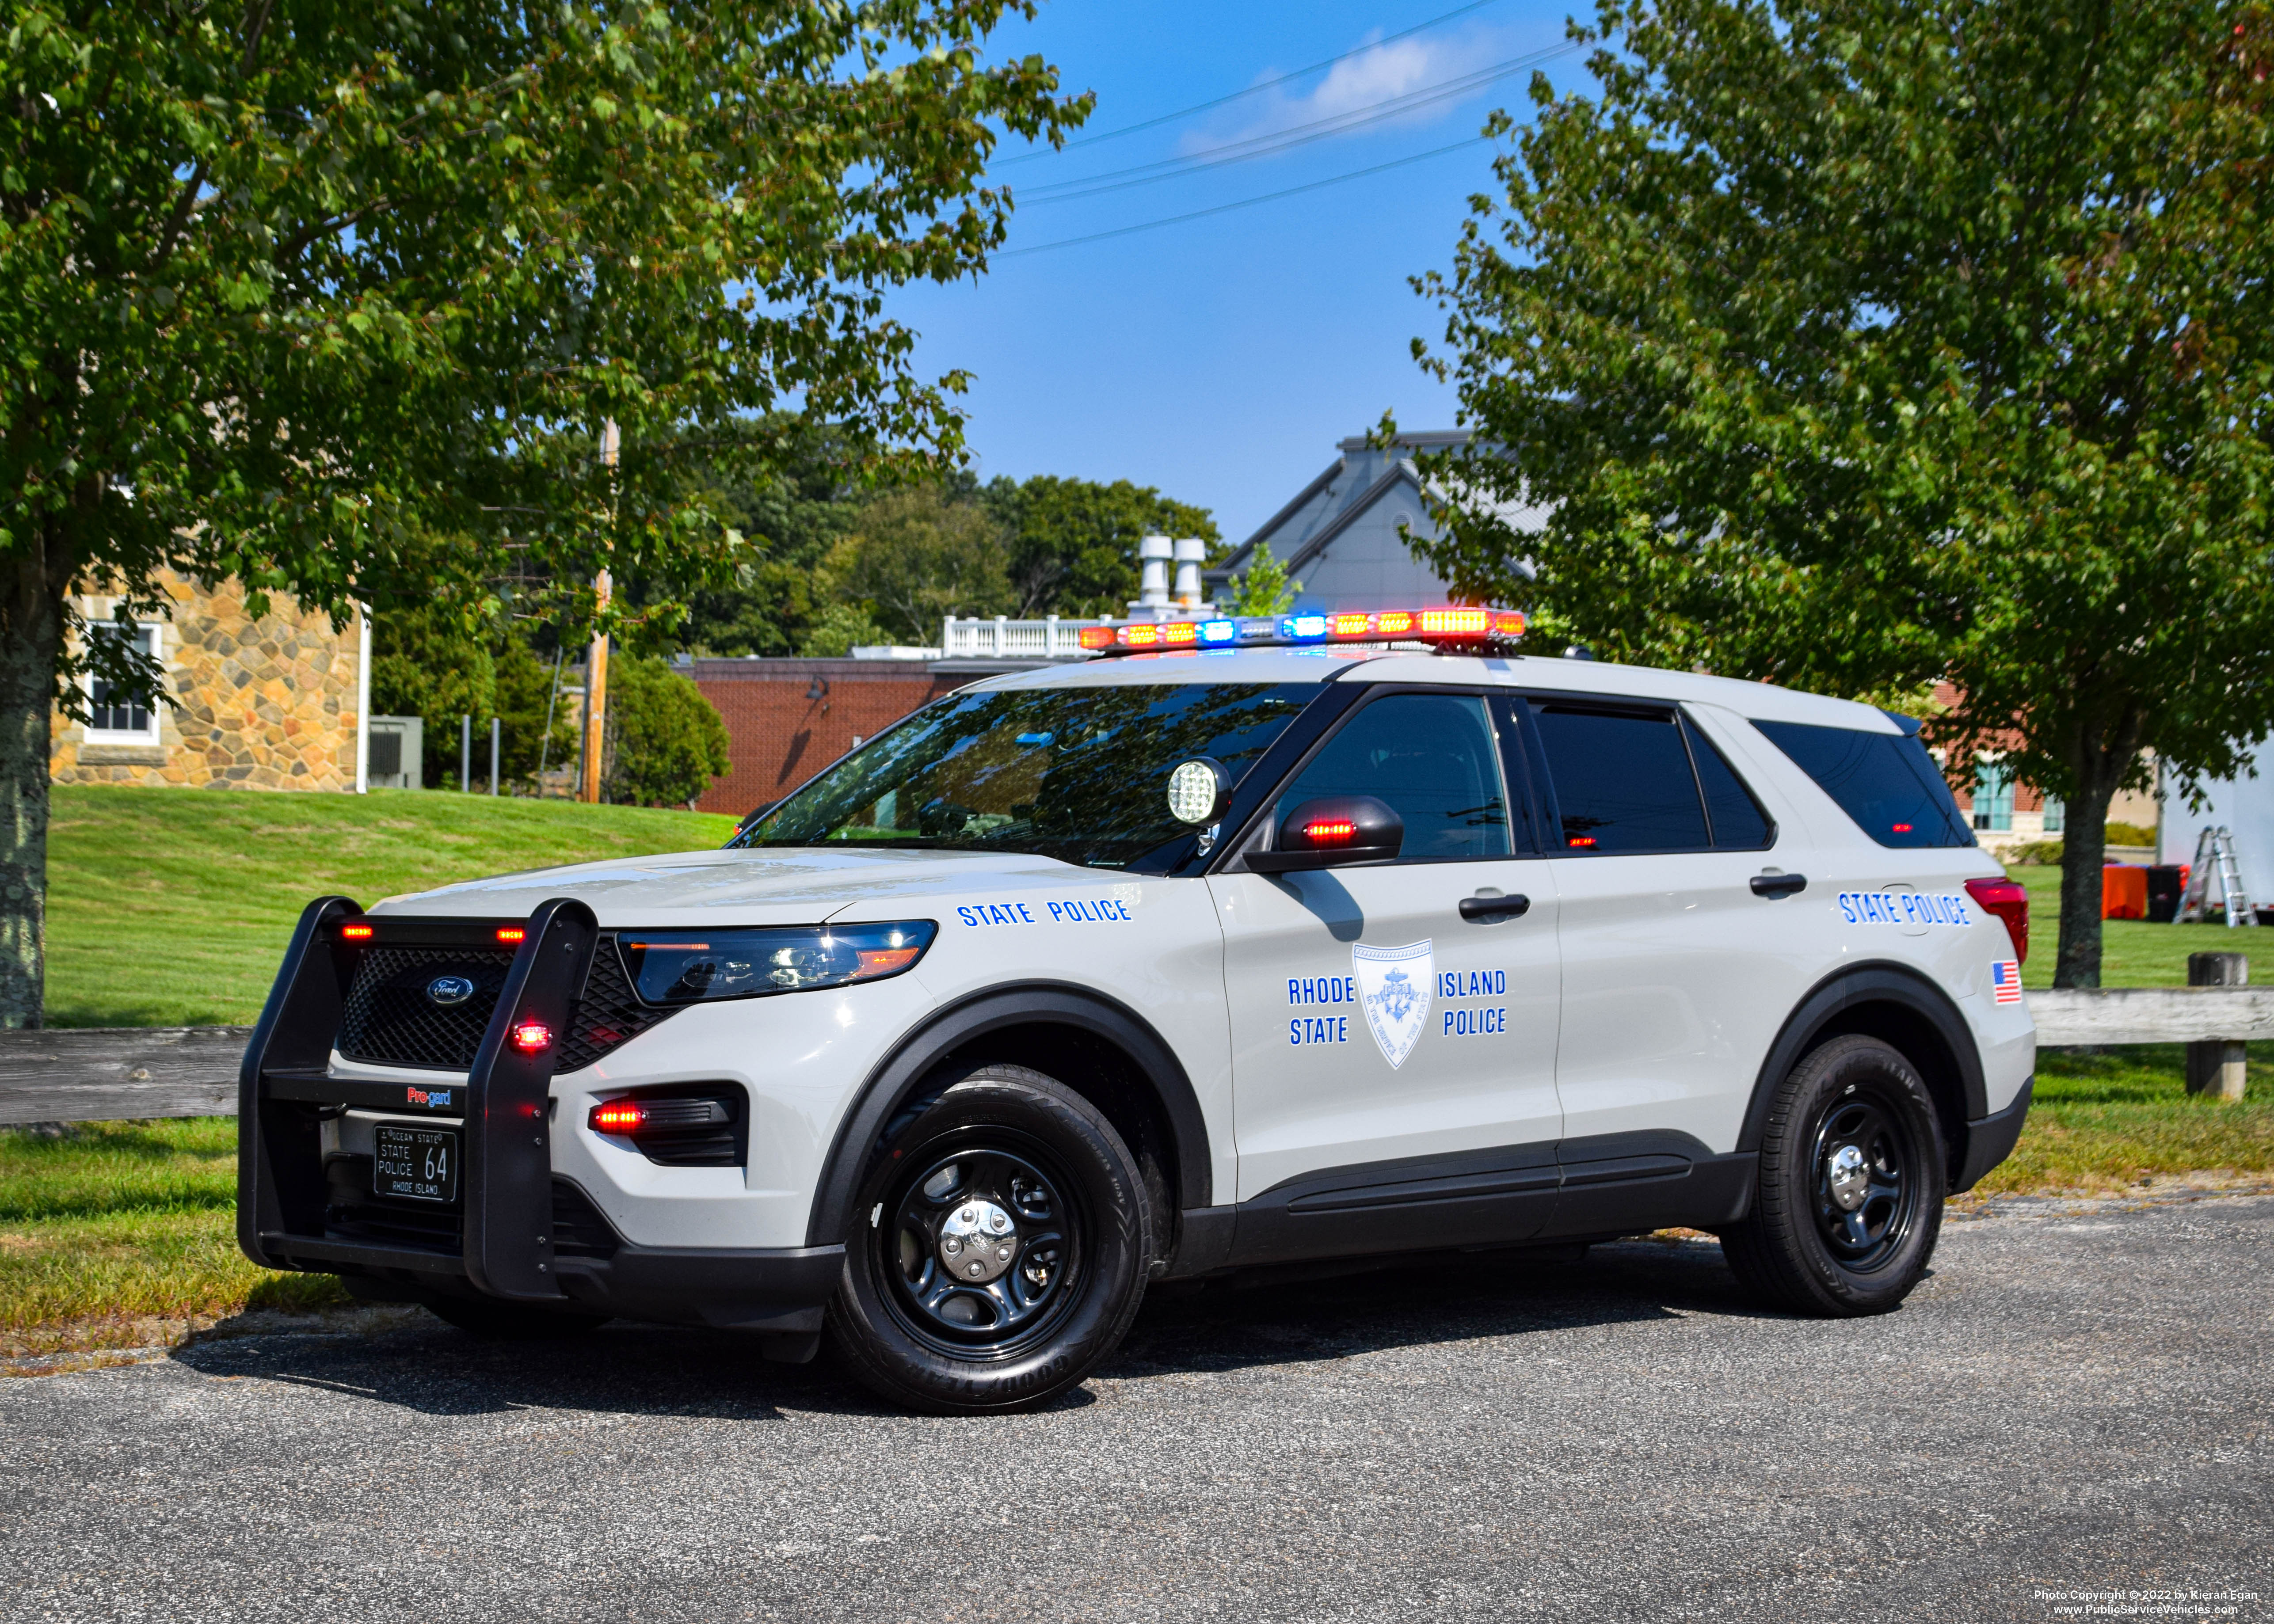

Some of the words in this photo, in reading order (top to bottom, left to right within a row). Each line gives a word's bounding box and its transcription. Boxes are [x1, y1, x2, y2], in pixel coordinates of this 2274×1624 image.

[957, 902, 1036, 927] STATE
[1046, 899, 1132, 922] POLICE
[1839, 892, 1901, 924] STATE
[1901, 894, 1971, 926] POLICE
[434, 980, 461, 996] Ford
[1287, 976, 1355, 1005] RHODE
[1437, 970, 1506, 998] ISLAND
[1289, 1016, 1348, 1046] STATE
[1443, 1008, 1507, 1037] POLICE
[408, 1087, 451, 1107] Pro-gard
[392, 1131, 413, 1141] OCEAN
[418, 1134, 438, 1144] STATE
[381, 1145, 410, 1159] STATE
[378, 1160, 413, 1176] POLICE
[425, 1147, 447, 1181] 64
[392, 1181, 413, 1192] RHODE
[415, 1183, 438, 1195] ISLAND
